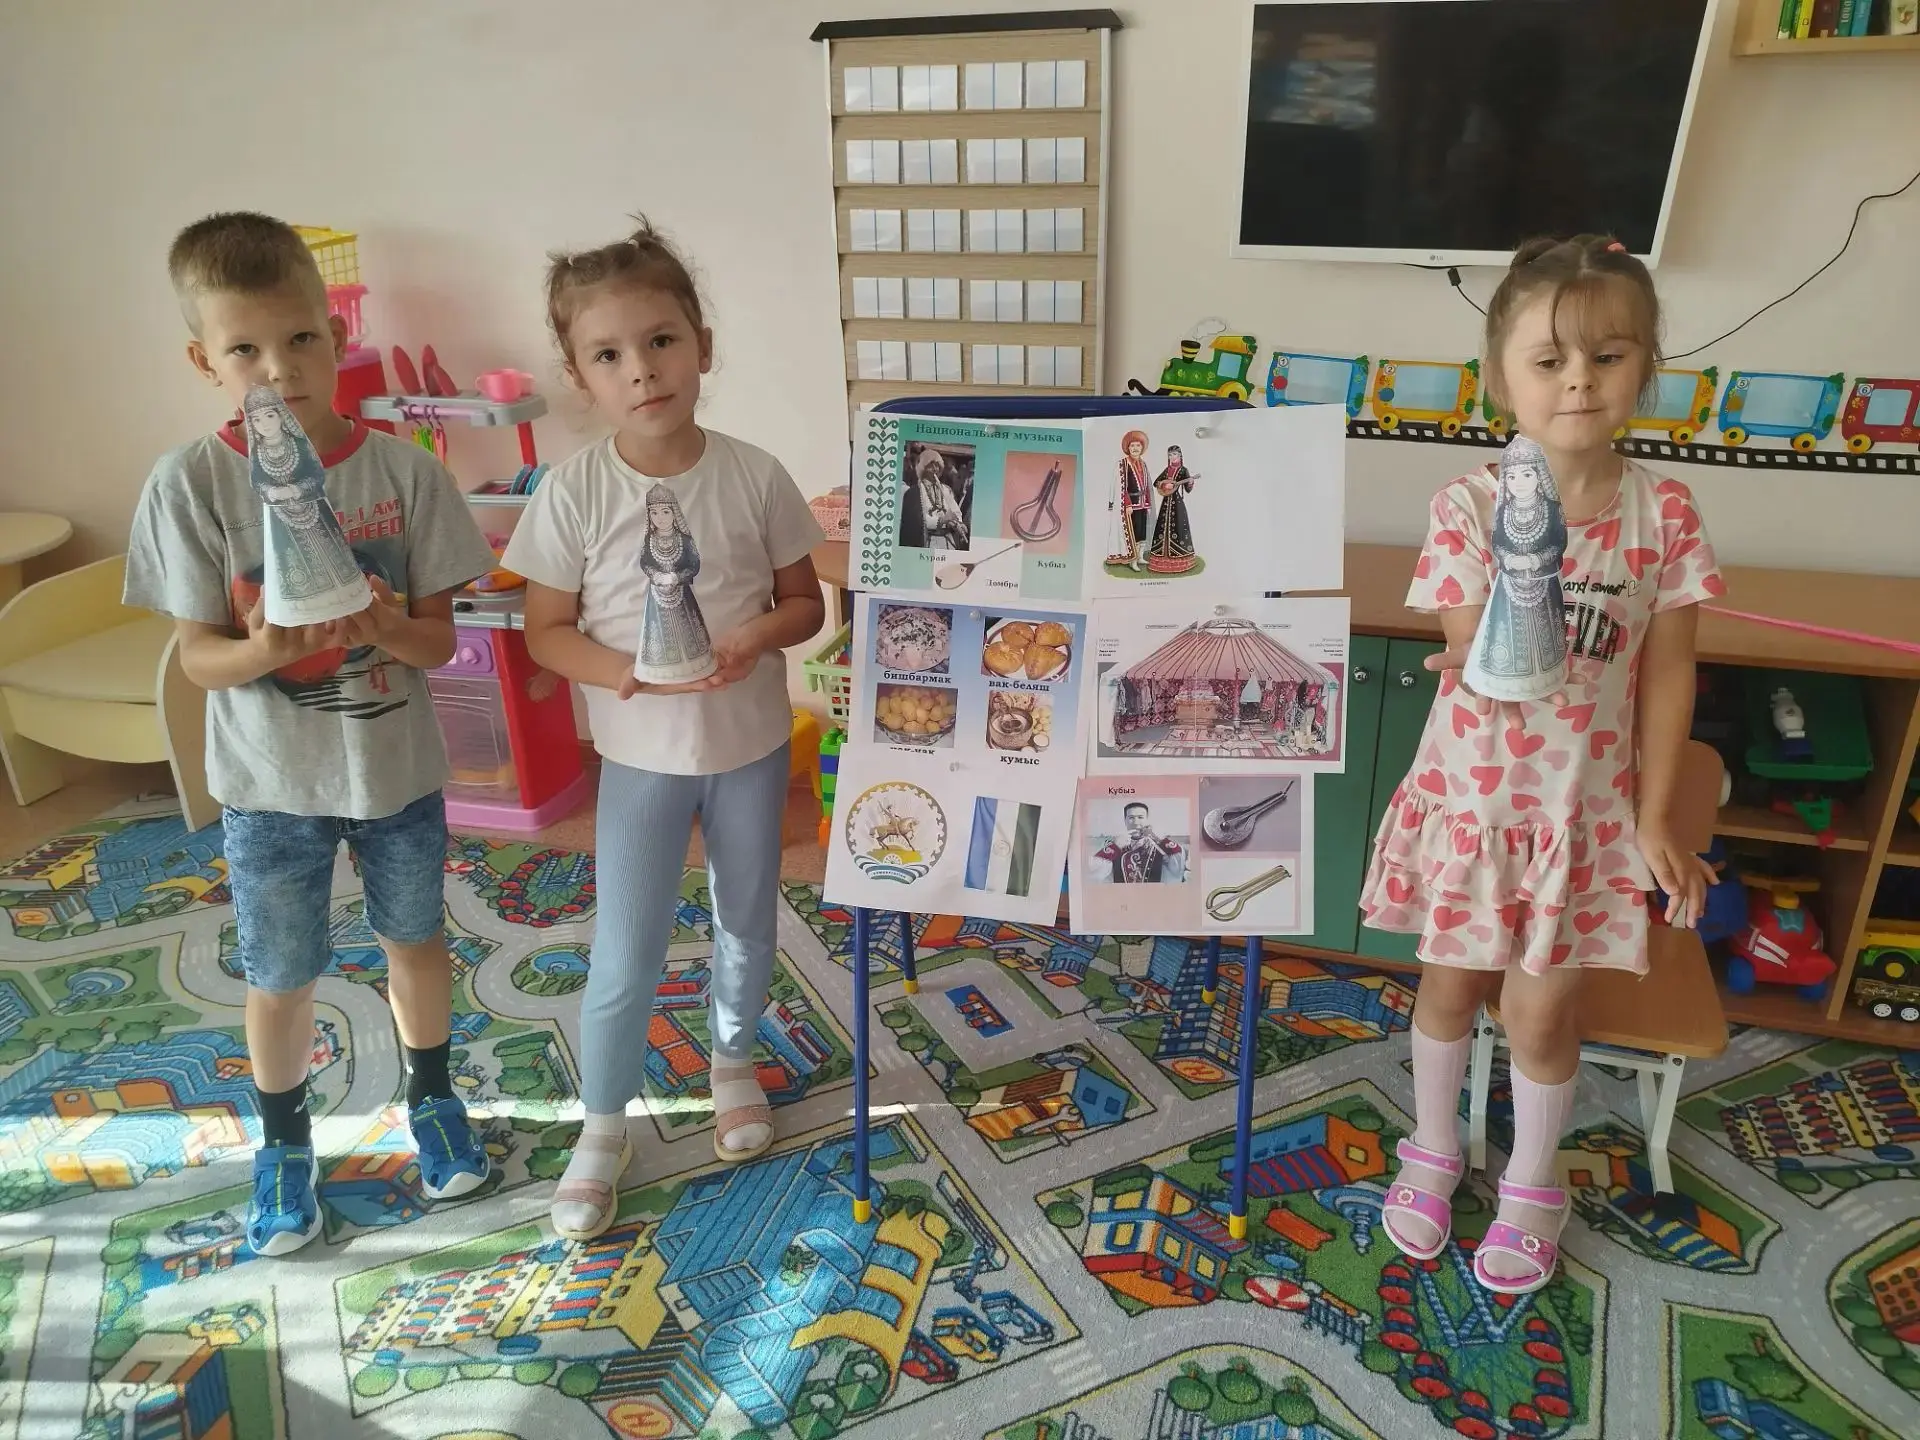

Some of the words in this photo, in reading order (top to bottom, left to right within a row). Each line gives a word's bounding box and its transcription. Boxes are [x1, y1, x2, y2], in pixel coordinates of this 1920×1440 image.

[1013, 433, 1063, 443] музыка
[371, 497, 399, 518] AM
[1037, 560, 1066, 569] Кубыз
[1563, 575, 1590, 594] and
[1591, 580, 1627, 596] sweet
[883, 670, 952, 684] бишбармак
[988, 680, 1050, 692] вак-беляш
[1000, 755, 1040, 766] кумыс
[1108, 787, 1136, 795] Кубыз
